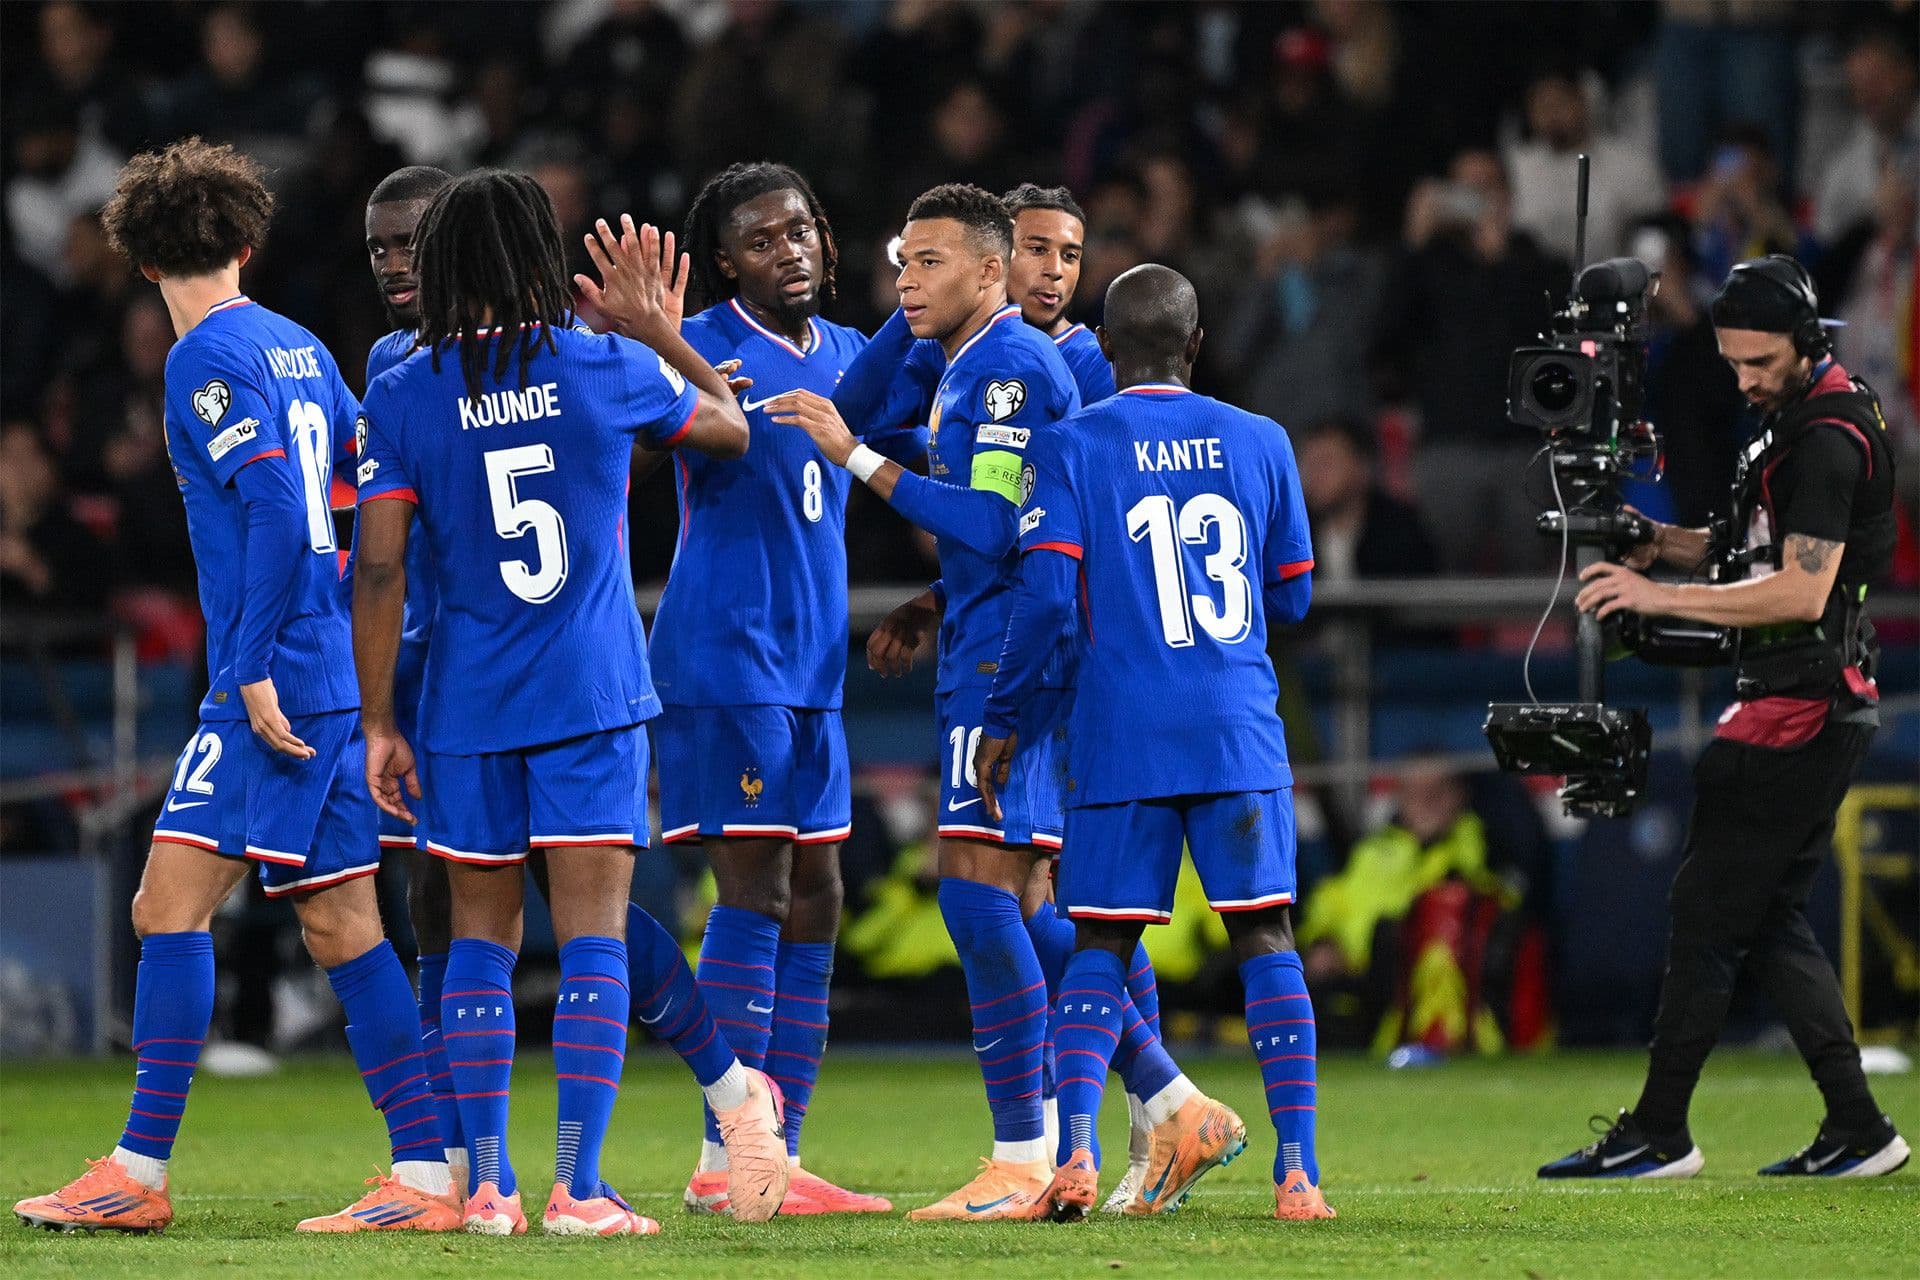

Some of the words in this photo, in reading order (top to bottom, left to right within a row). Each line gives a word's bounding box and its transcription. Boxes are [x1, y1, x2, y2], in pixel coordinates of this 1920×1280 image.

[457, 382, 561, 431] KOUNDE
[1133, 437, 1224, 472] KANTE
[803, 460, 823, 523] 8
[484, 443, 569, 604] 5
[1126, 493, 1252, 648] 13
[174, 732, 223, 795] 12
